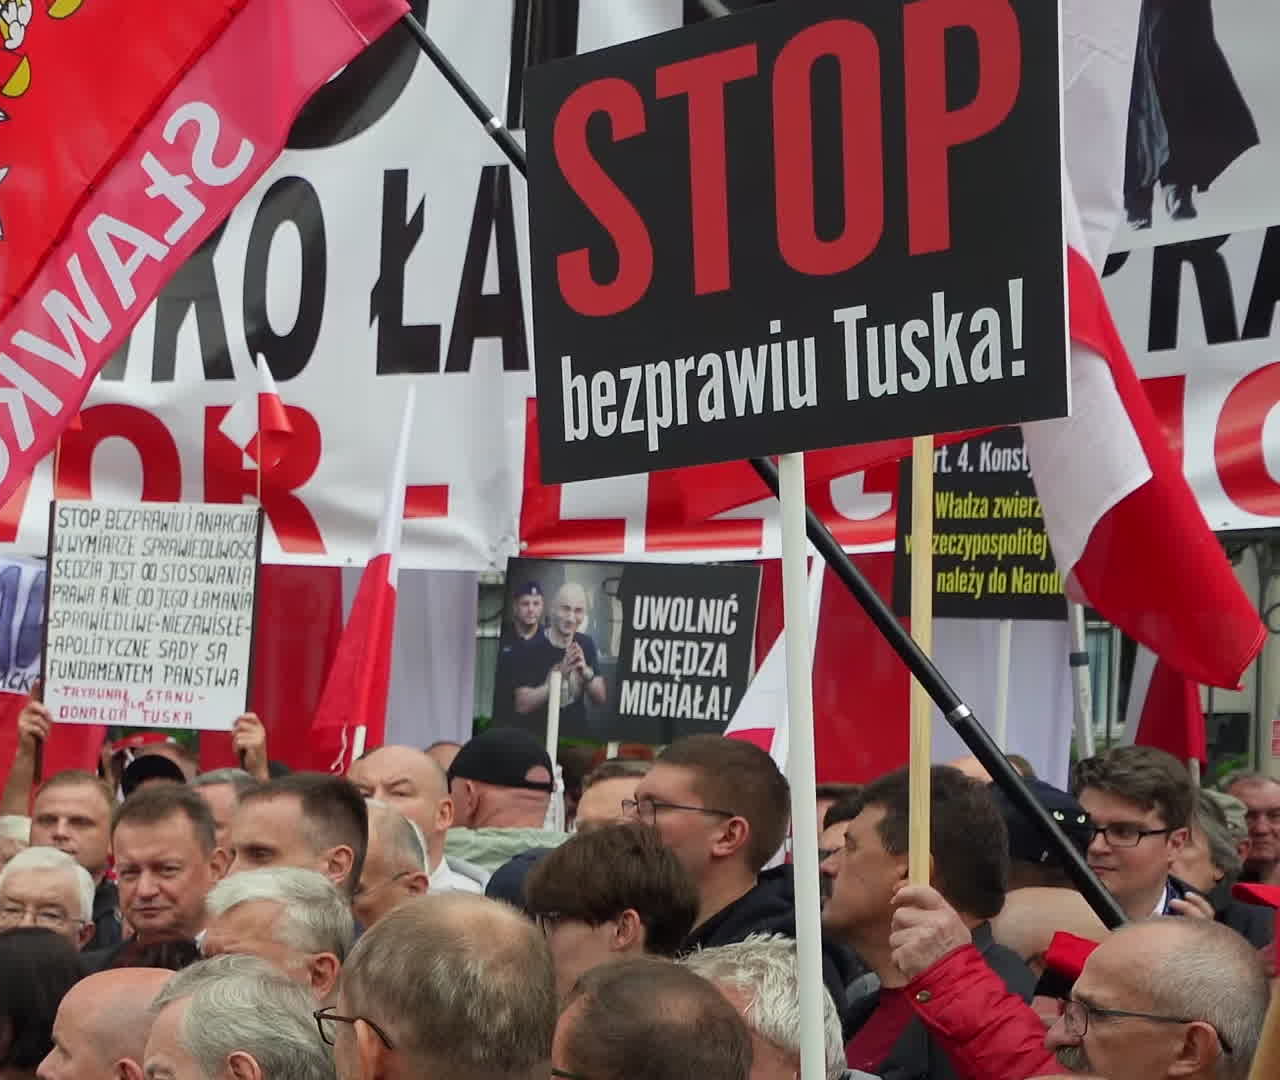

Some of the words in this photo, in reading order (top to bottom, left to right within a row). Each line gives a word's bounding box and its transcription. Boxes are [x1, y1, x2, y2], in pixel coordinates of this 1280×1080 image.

[553, 0, 1022, 317] STOP
[561, 319, 818, 452] bezprawiu
[834, 278, 1026, 402] Tuska!
[934, 445, 952, 473] rt.
[956, 443, 975, 473] 4.
[58, 507, 101, 528] STOP
[935, 490, 989, 519] Władza
[993, 490, 1046, 519] zwierz
[931, 528, 1047, 562] zeczypospolitej
[936, 565, 985, 599] należy
[989, 566, 1007, 594] do
[632, 593, 739, 635] UWOLNIĆ
[49, 658, 154, 683] FUNDAMENTEM
[631, 637, 728, 682] KSIĘDZA
[619, 679, 732, 721] MICHAŁA!
